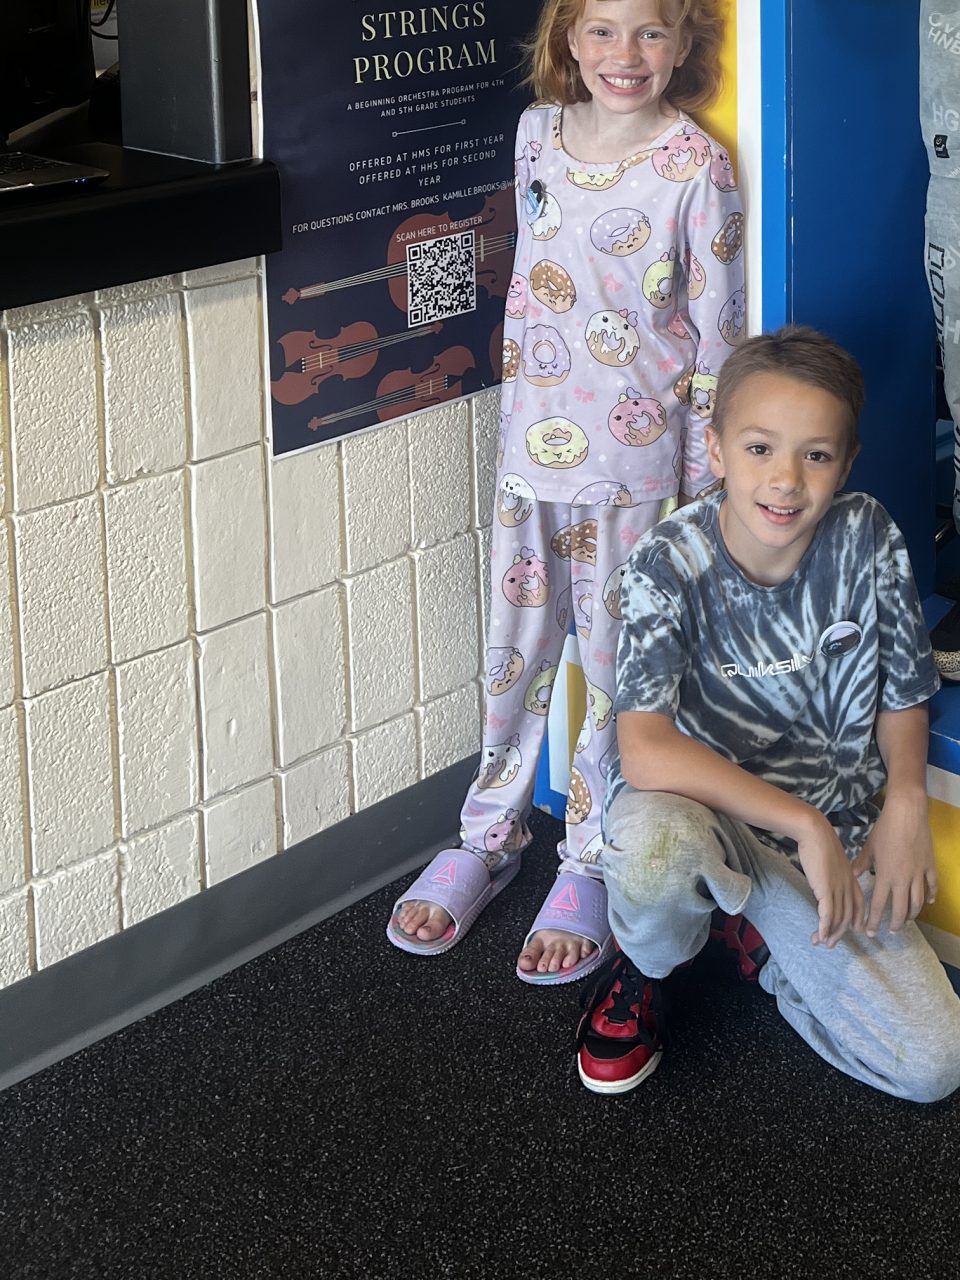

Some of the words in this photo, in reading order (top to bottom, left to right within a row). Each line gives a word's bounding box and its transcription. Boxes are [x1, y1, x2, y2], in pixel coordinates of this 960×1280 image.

[361, 1, 486, 42] STRINGS
[353, 38, 497, 84] PROGRAM
[355, 96, 395, 110] BEGINNING
[398, 89, 440, 102] ORCHESTRA
[442, 84, 474, 95] PROGRAM
[476, 81, 489, 89] FOR
[491, 79, 504, 87] 4TH
[380, 108, 395, 117] AND
[399, 106, 413, 115] 5TH
[415, 101, 438, 112] GRADE
[440, 95, 475, 108] STUDENTS
[349, 156, 392, 172] OFFERED
[396, 153, 408, 162] AT
[412, 148, 430, 160] HMS
[434, 144, 450, 155] FOR
[455, 138, 480, 151] FIRST
[483, 134, 504, 146] YEAR
[359, 168, 401, 185] OFFERED
[405, 165, 416, 176] AT
[421, 161, 438, 173] HHS
[442, 156, 458, 168] FOR
[463, 149, 496, 164] SECOND
[418, 175, 441, 187] YEAR
[292, 223, 309, 234] FOR
[310, 213, 353, 231] QUESTIONS
[356, 205, 390, 221] CONTACT
[392, 202, 410, 213] MRS.
[411, 195, 440, 209] BROOKS
[396, 232, 416, 243] SCAN
[417, 227, 436, 239] HERE
[438, 224, 448, 234] TO
[449, 215, 483, 231] REGISTER
